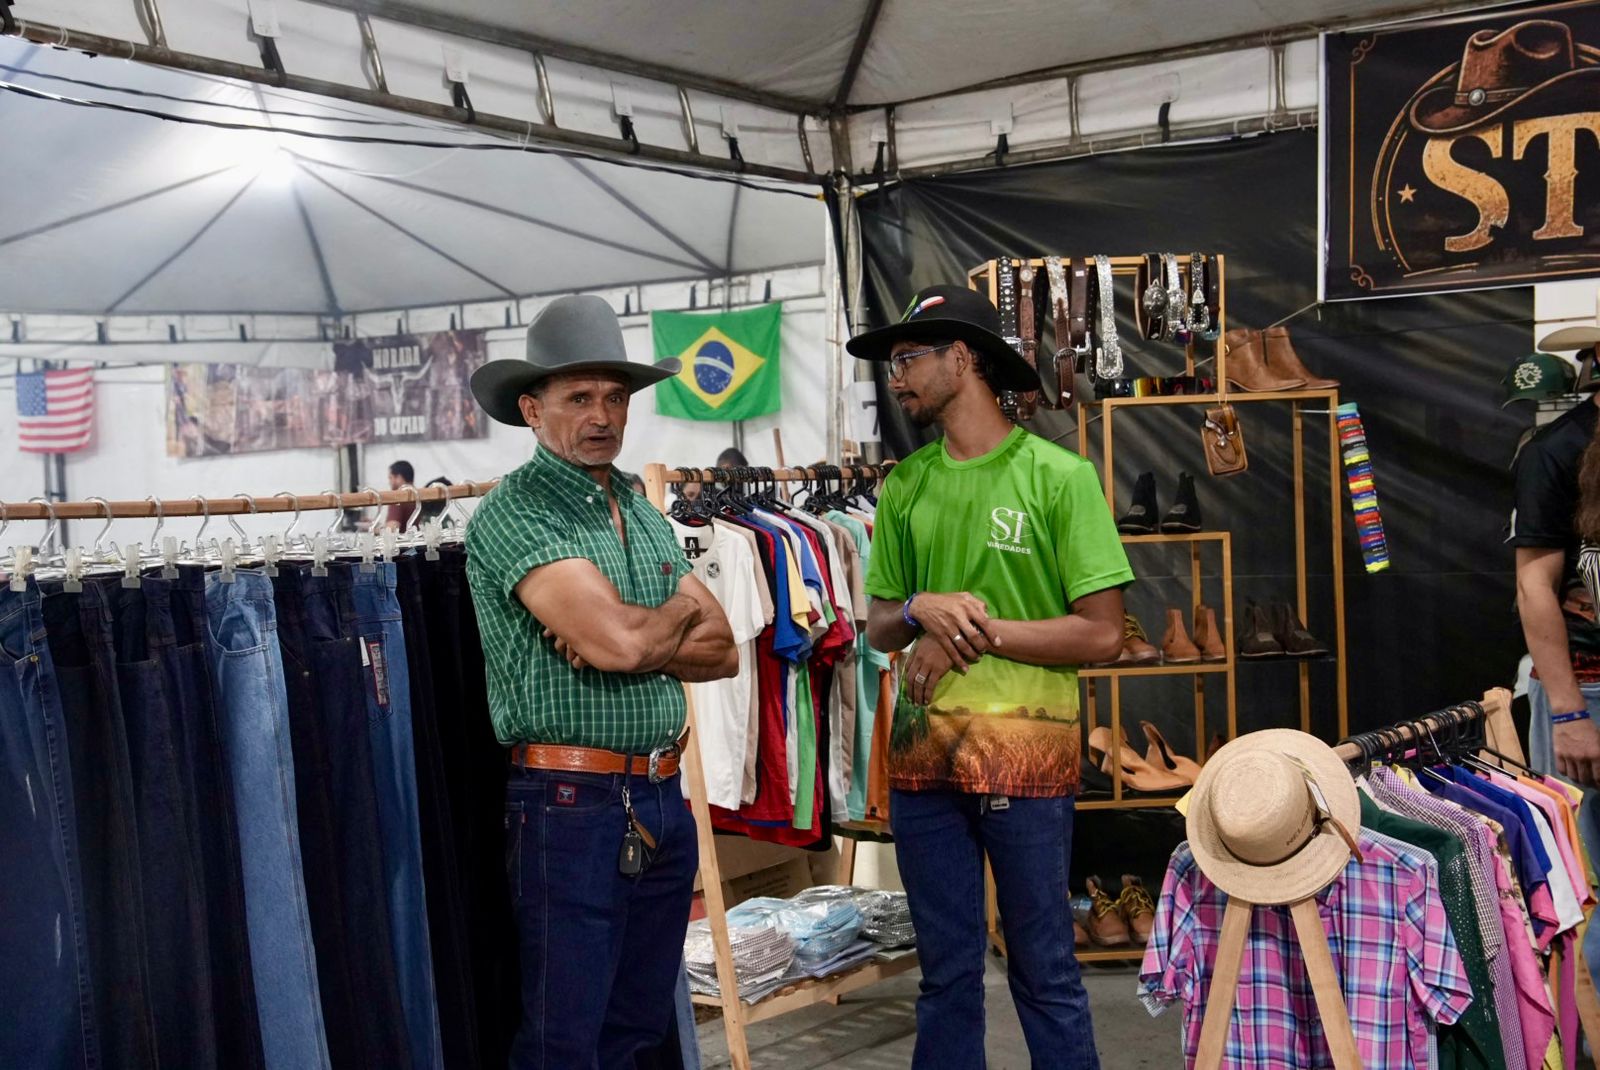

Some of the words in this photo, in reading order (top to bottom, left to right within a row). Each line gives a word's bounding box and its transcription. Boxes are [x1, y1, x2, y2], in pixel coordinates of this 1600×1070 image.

[1422, 111, 1600, 252] ST
[372, 345, 420, 369] MORADA
[991, 506, 1028, 544] ST
